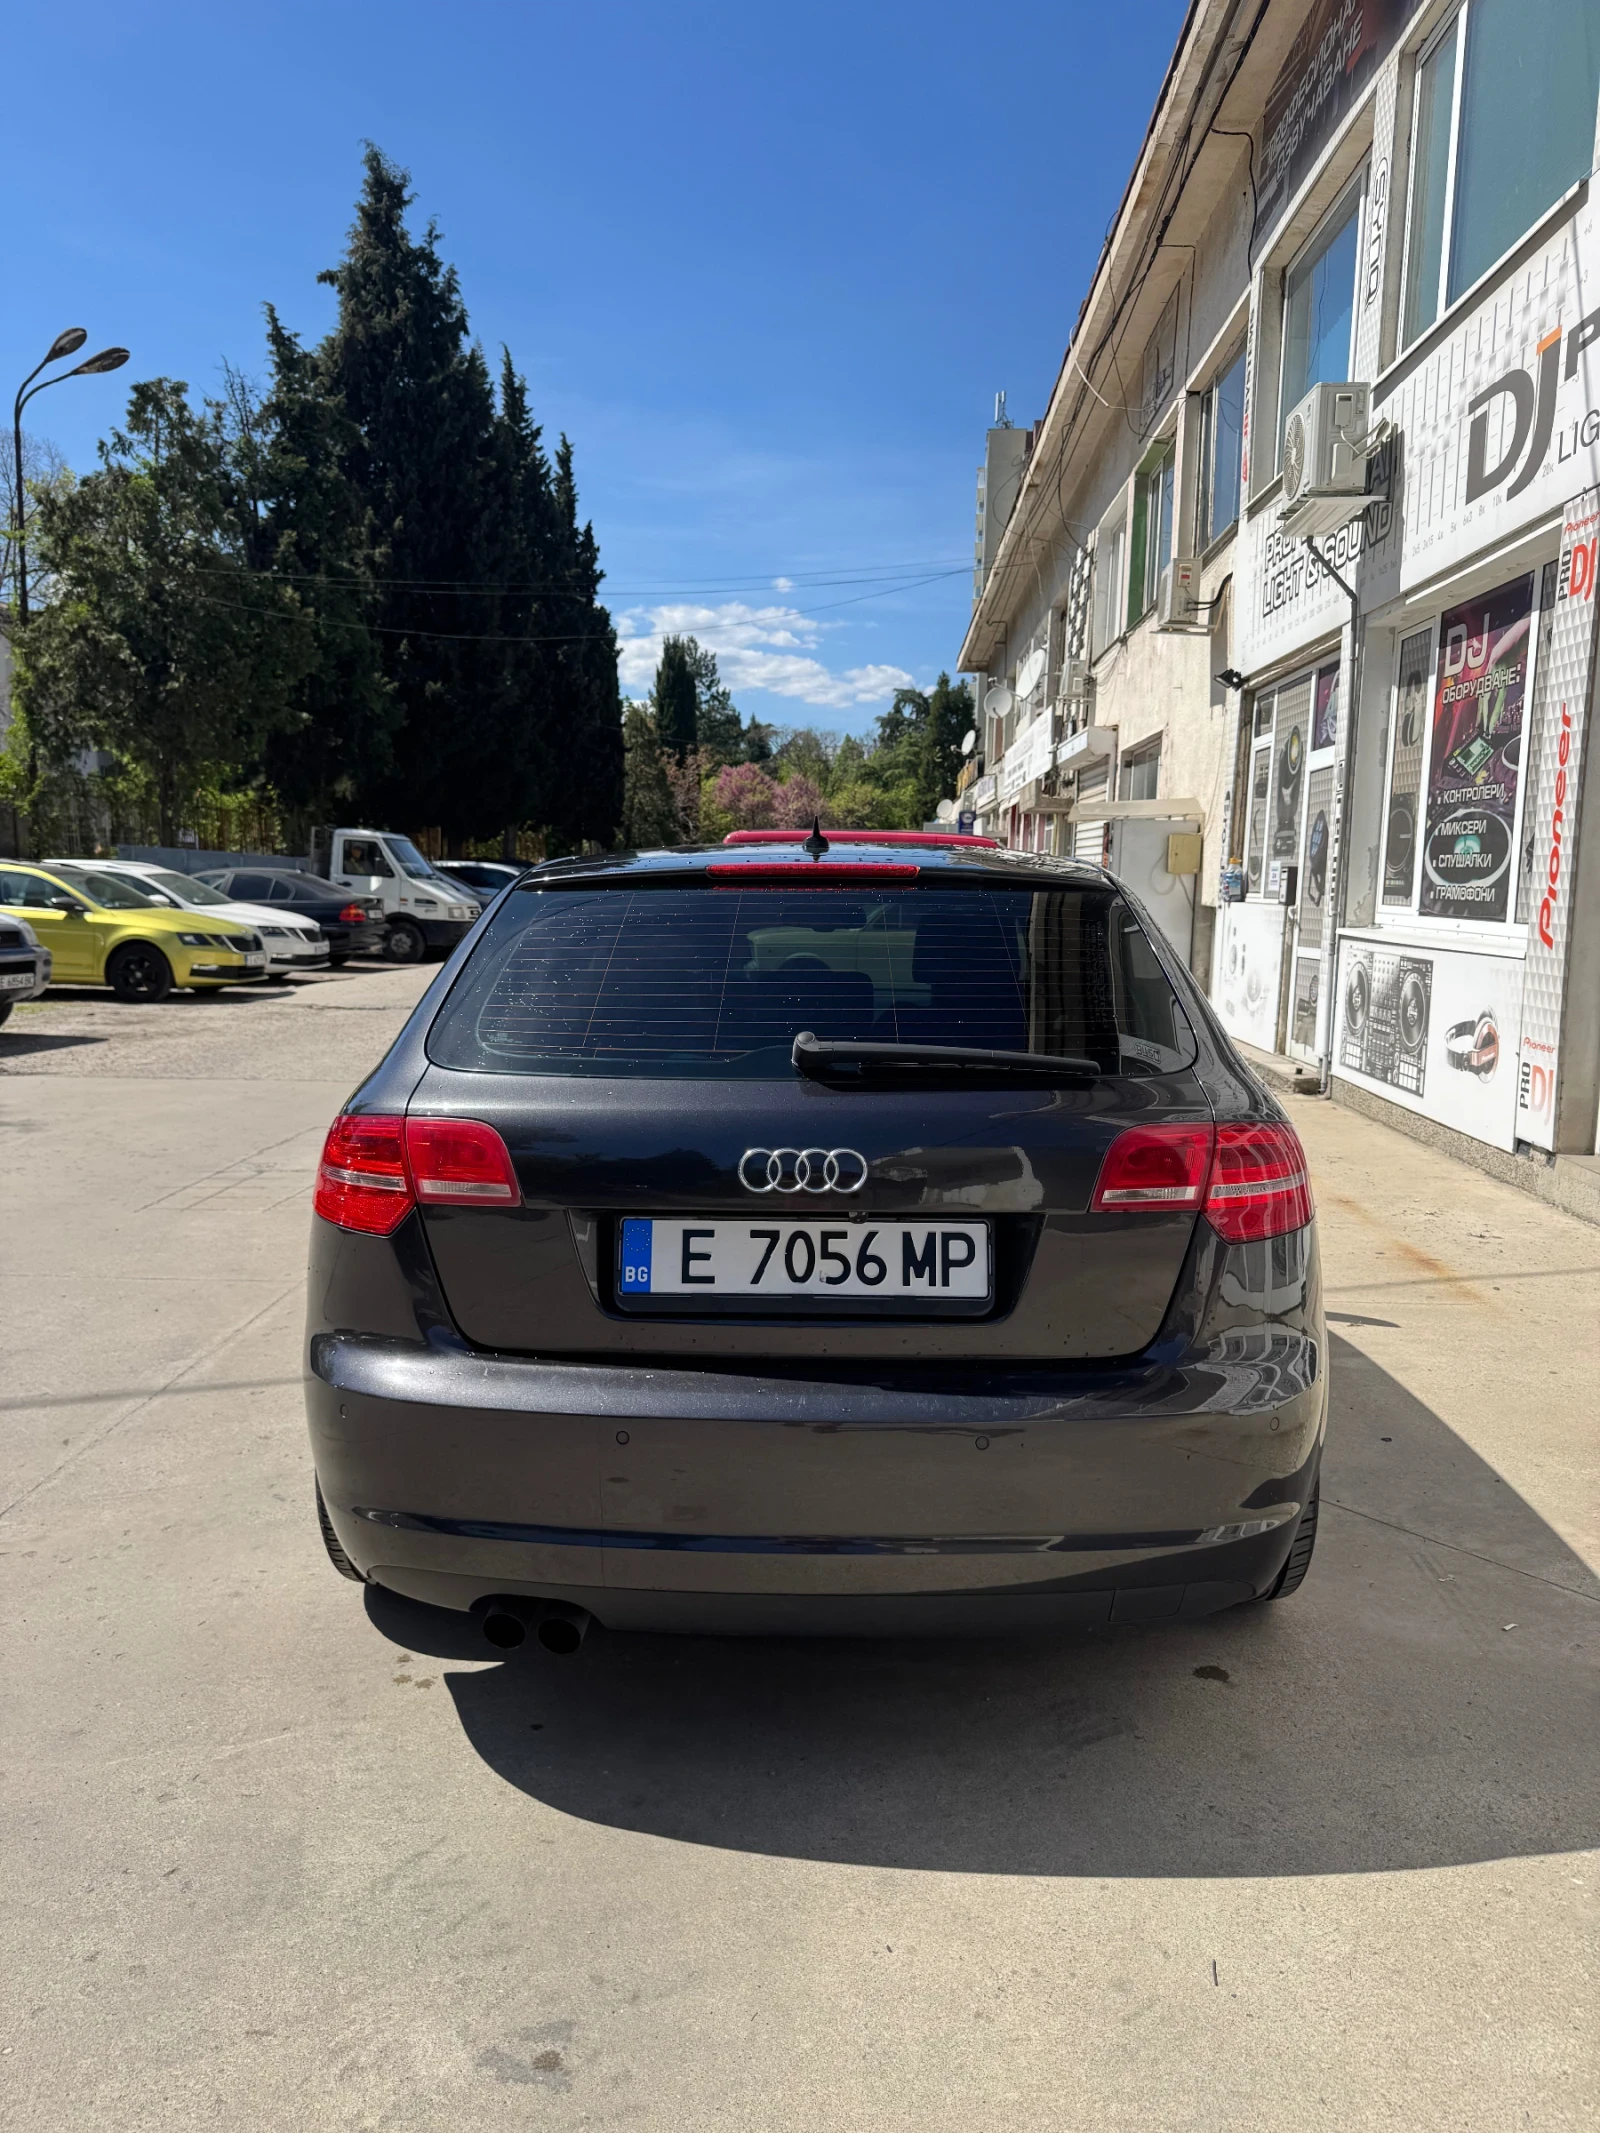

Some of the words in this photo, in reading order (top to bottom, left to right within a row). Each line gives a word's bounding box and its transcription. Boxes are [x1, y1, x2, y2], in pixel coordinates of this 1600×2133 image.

[1268, 0, 1357, 166] ПРОФЕСИОНА
[1465, 325, 1562, 506] DJ
[1263, 554, 1305, 619] LIGHT
[1323, 501, 1394, 578] SOUND
[1558, 549, 1572, 602] PRO
[1569, 537, 1597, 602] DJ
[1444, 612, 1490, 678] DJ
[1442, 663, 1522, 704] ОБОРУДВАНЕ:
[1443, 783, 1505, 804] КОНТРОЛЕРИ
[1440, 819, 1487, 836] МИКСЕРИ
[1539, 702, 1571, 950] Pioneer
[1435, 885, 1495, 902] ГРАМОФОНИ
[1523, 1036, 1556, 1054] Pioneer
[1519, 1061, 1531, 1110] PRO
[1531, 1064, 1554, 1127] DJ
[625, 1266, 649, 1283] BG
[681, 1229, 716, 1284] E
[749, 1229, 888, 1286] 7056
[902, 1231, 976, 1287] MP
